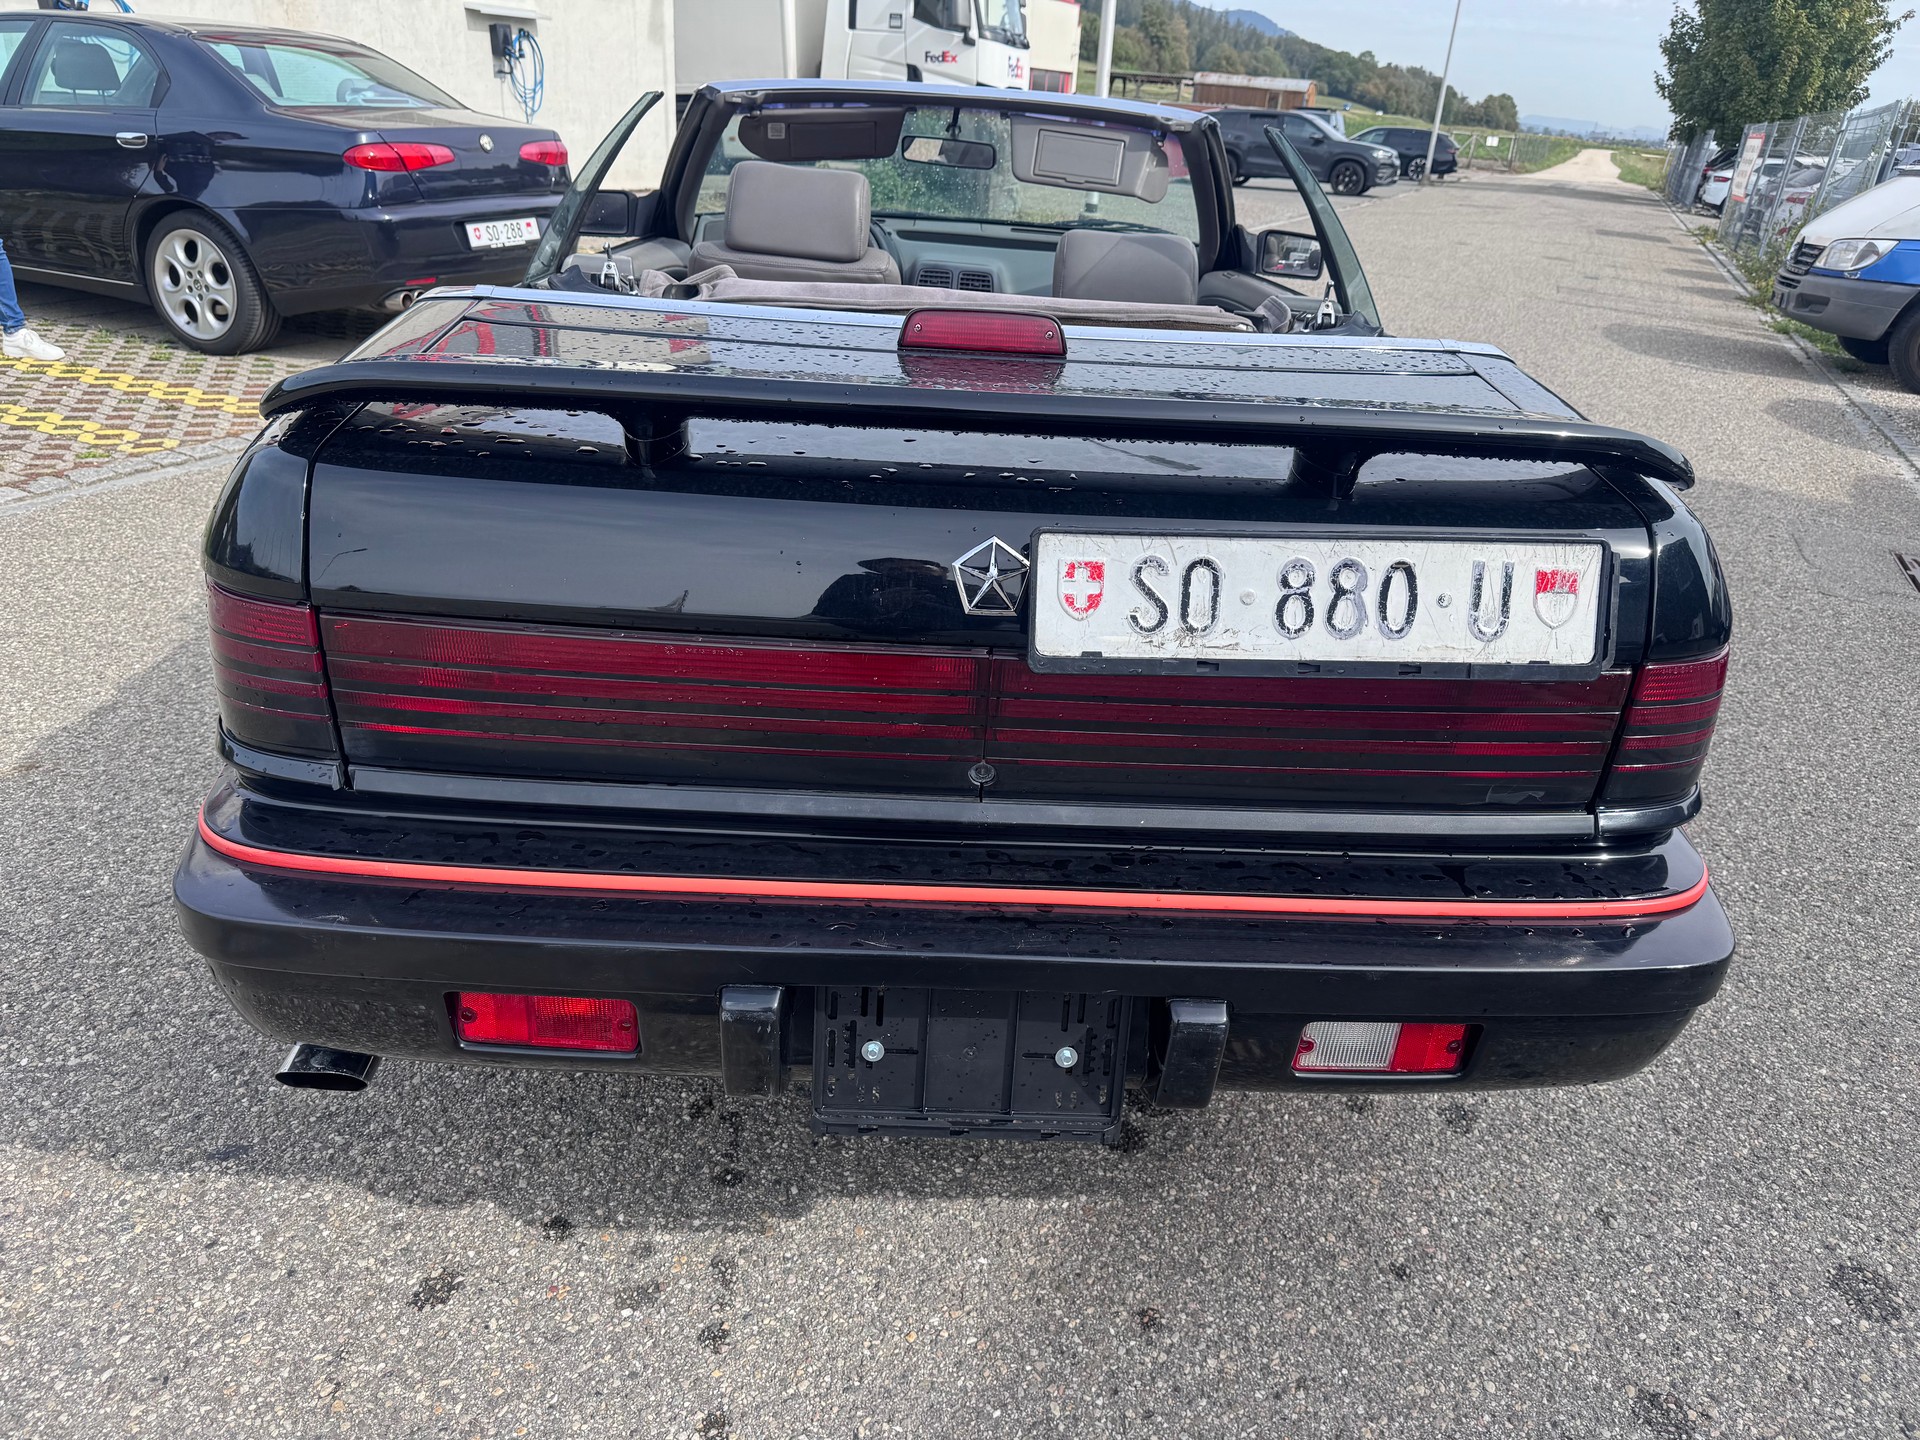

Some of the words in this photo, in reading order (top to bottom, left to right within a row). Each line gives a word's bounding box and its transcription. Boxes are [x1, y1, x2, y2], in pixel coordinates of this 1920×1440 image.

[924, 51, 958, 64] FedEx
[1127, 555, 1223, 638] SO
[1273, 556, 1420, 641] 880
[1468, 559, 1514, 642] U
